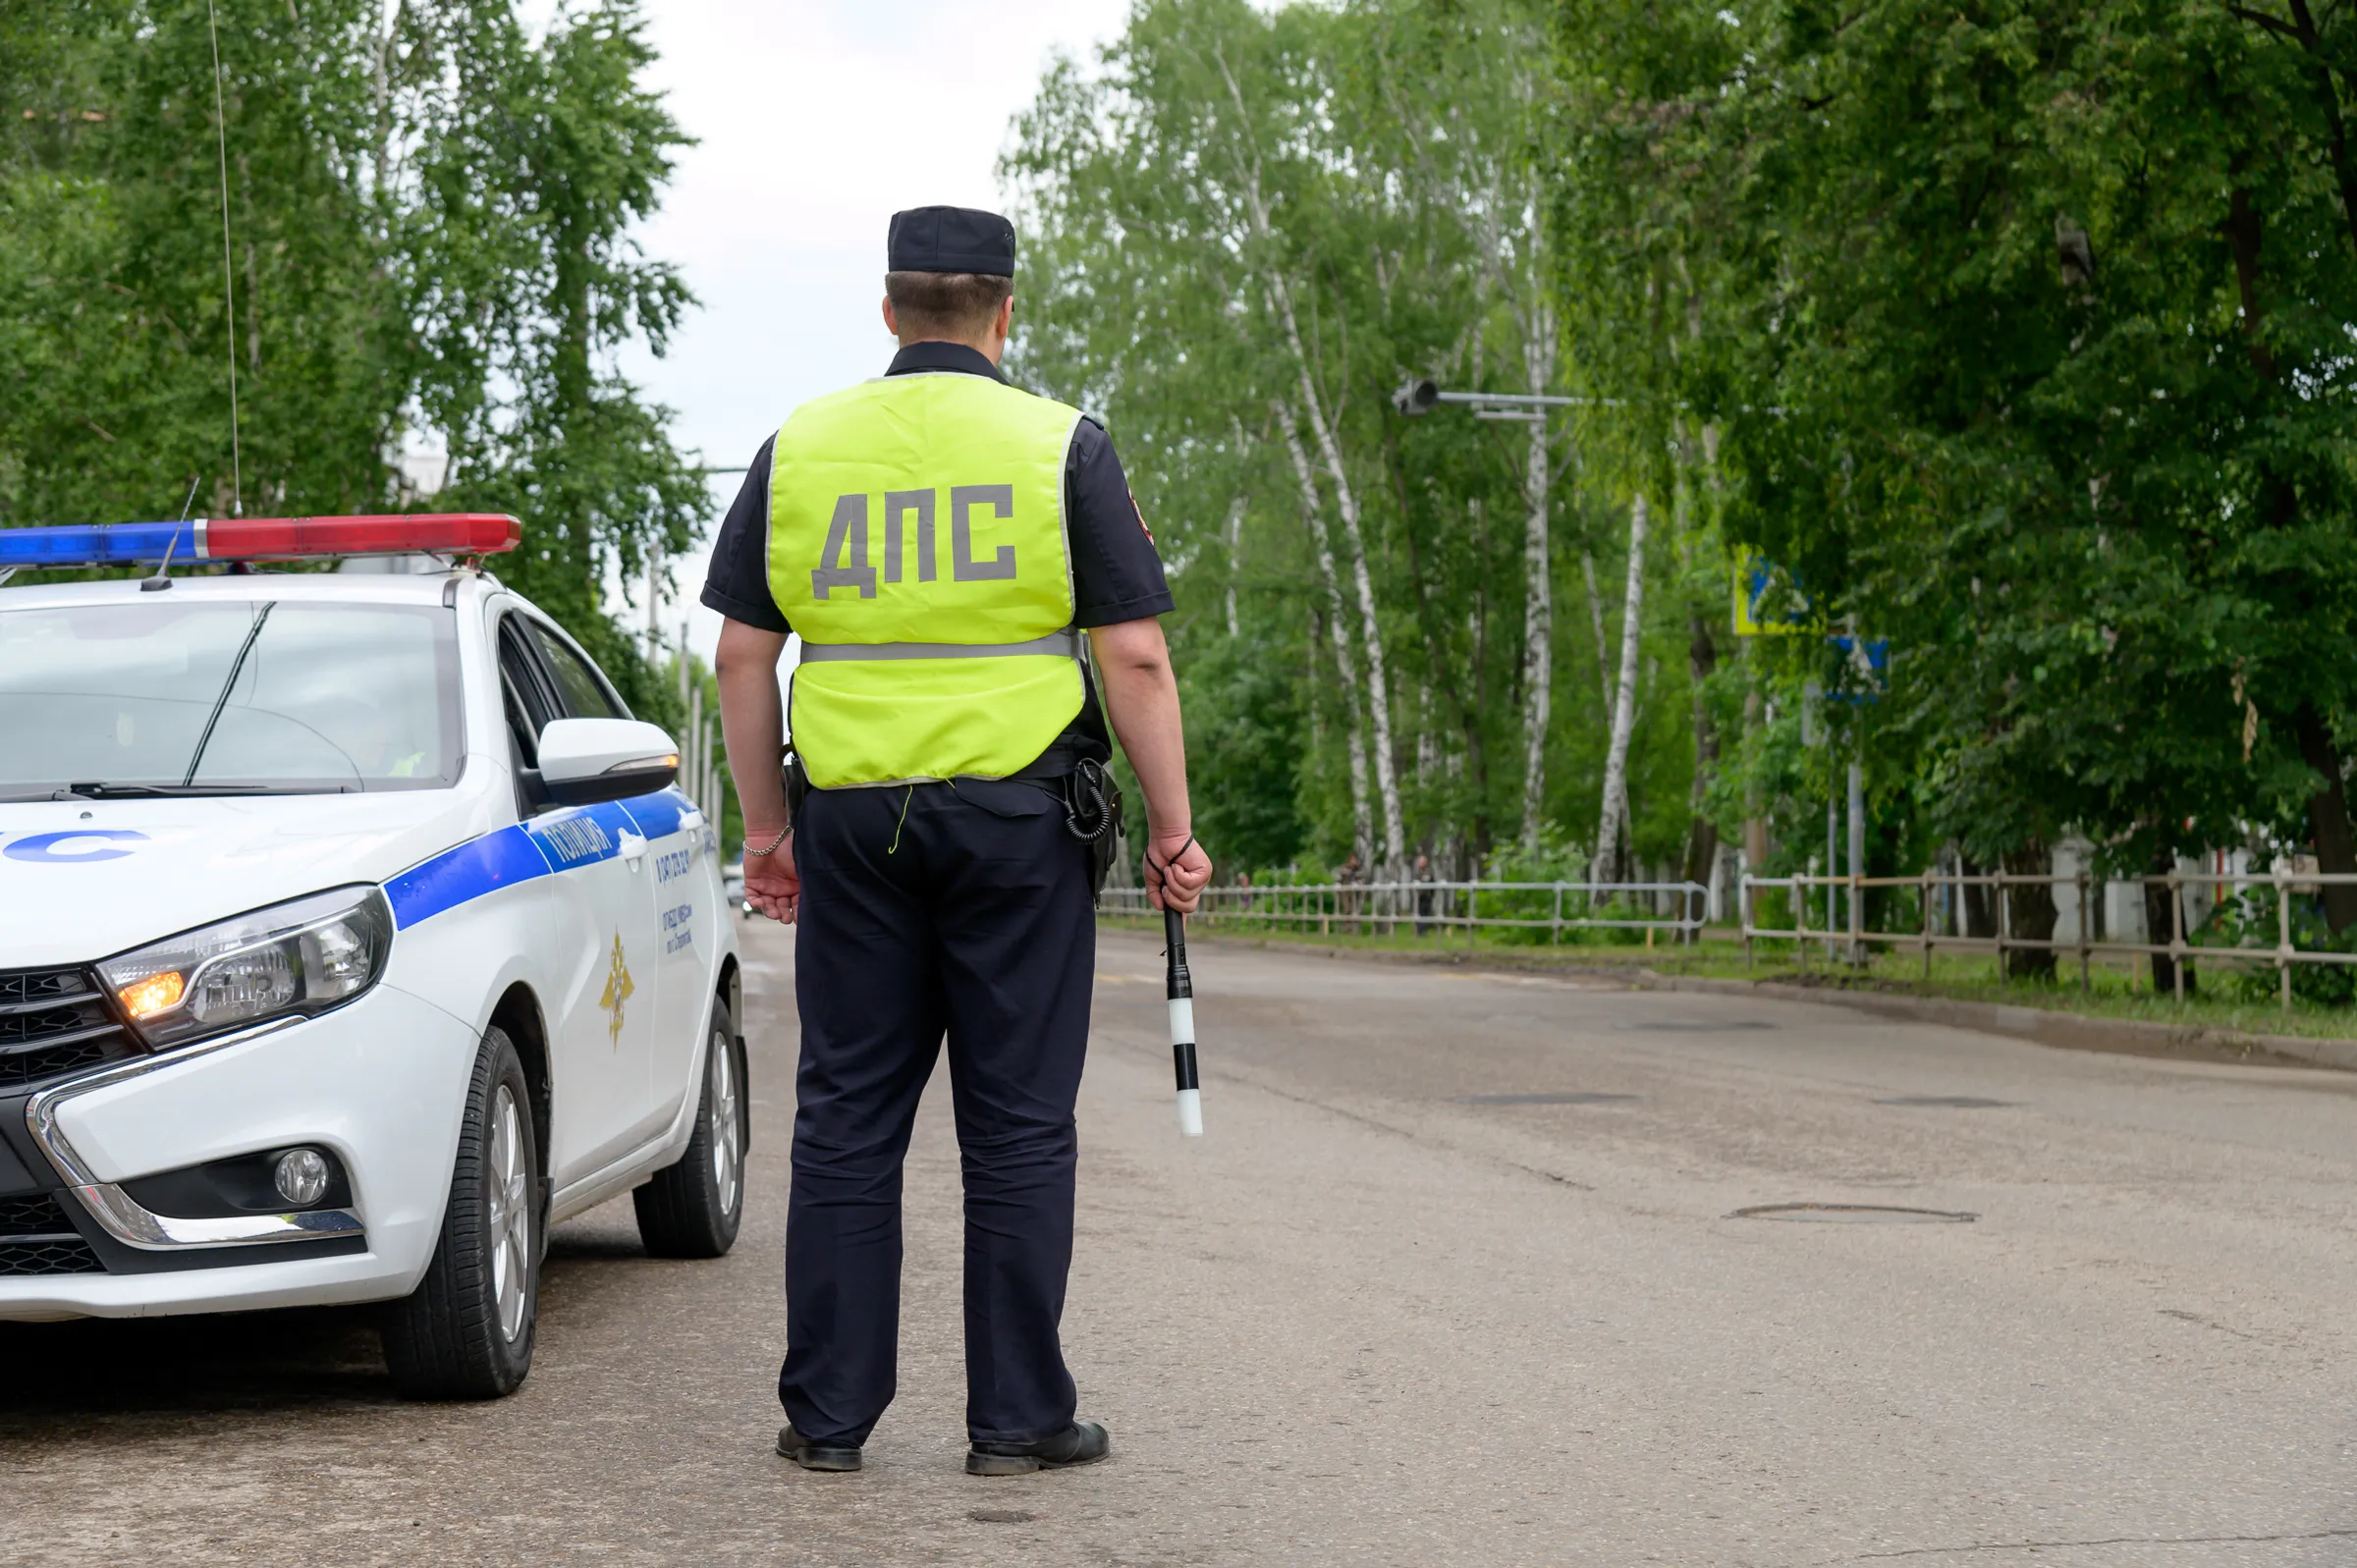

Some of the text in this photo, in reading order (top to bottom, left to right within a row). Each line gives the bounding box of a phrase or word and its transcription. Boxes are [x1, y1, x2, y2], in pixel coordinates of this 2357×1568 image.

[811, 484, 1016, 600] ДПС
[0, 830, 151, 863] С
[541, 816, 613, 863] ПОЛИЦИЯ
